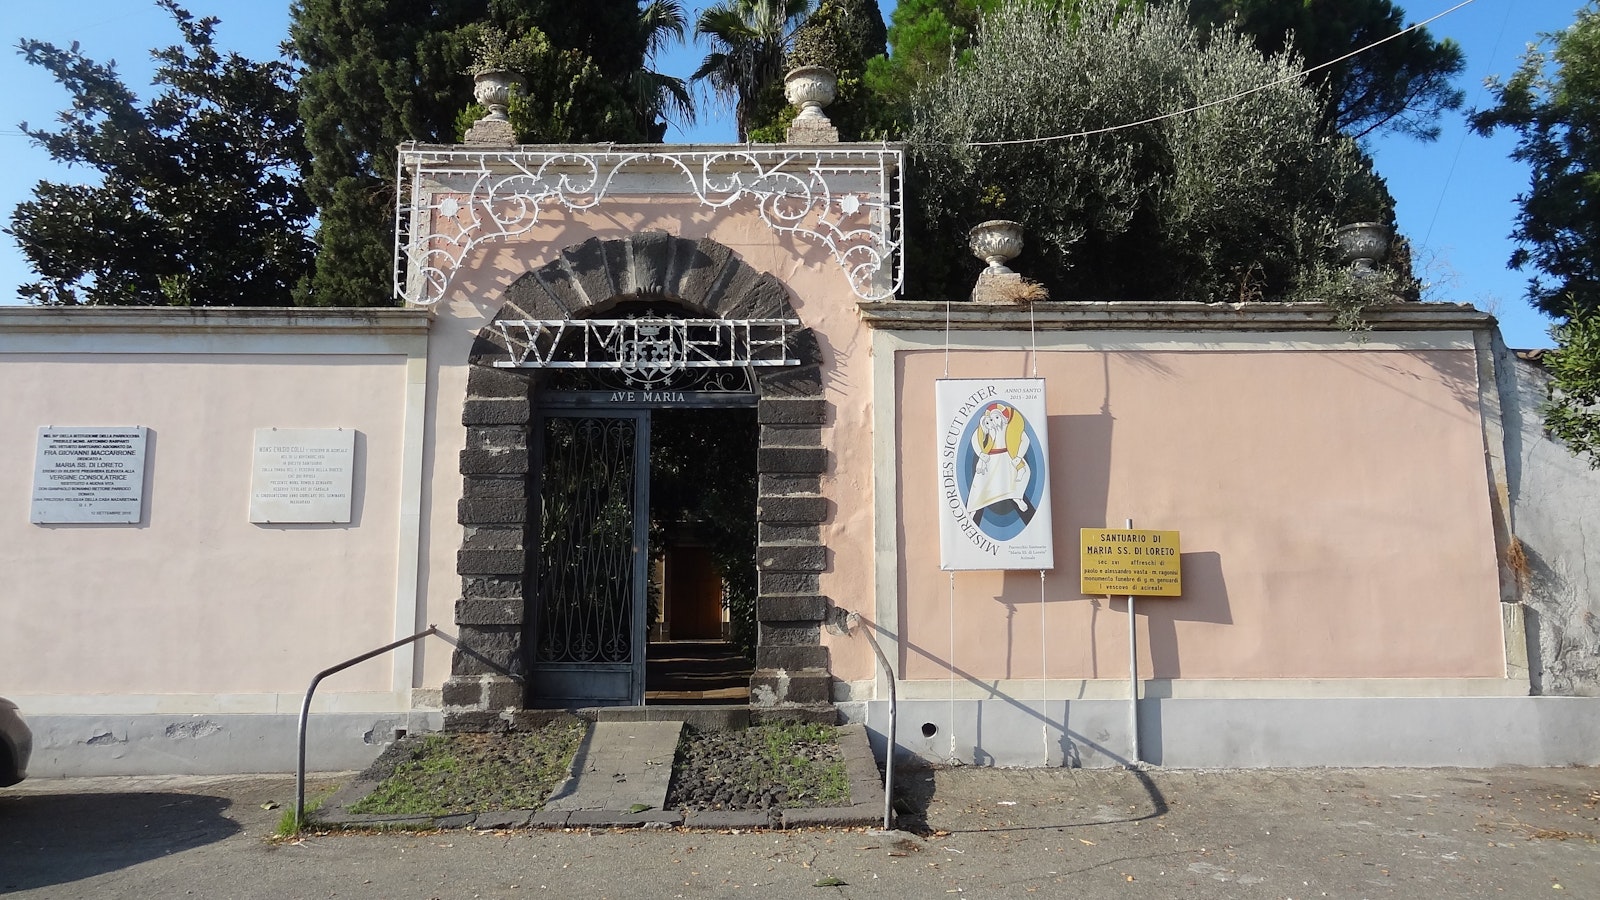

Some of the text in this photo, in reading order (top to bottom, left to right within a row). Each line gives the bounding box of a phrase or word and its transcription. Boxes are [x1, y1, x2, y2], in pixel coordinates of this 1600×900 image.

[584, 319, 786, 368] MARIA
[610, 392, 684, 402] AVE MARIA
[943, 386, 1000, 556] MISERICORDES SICUT PATER
[1101, 534, 1145, 542] SANTUARIO
